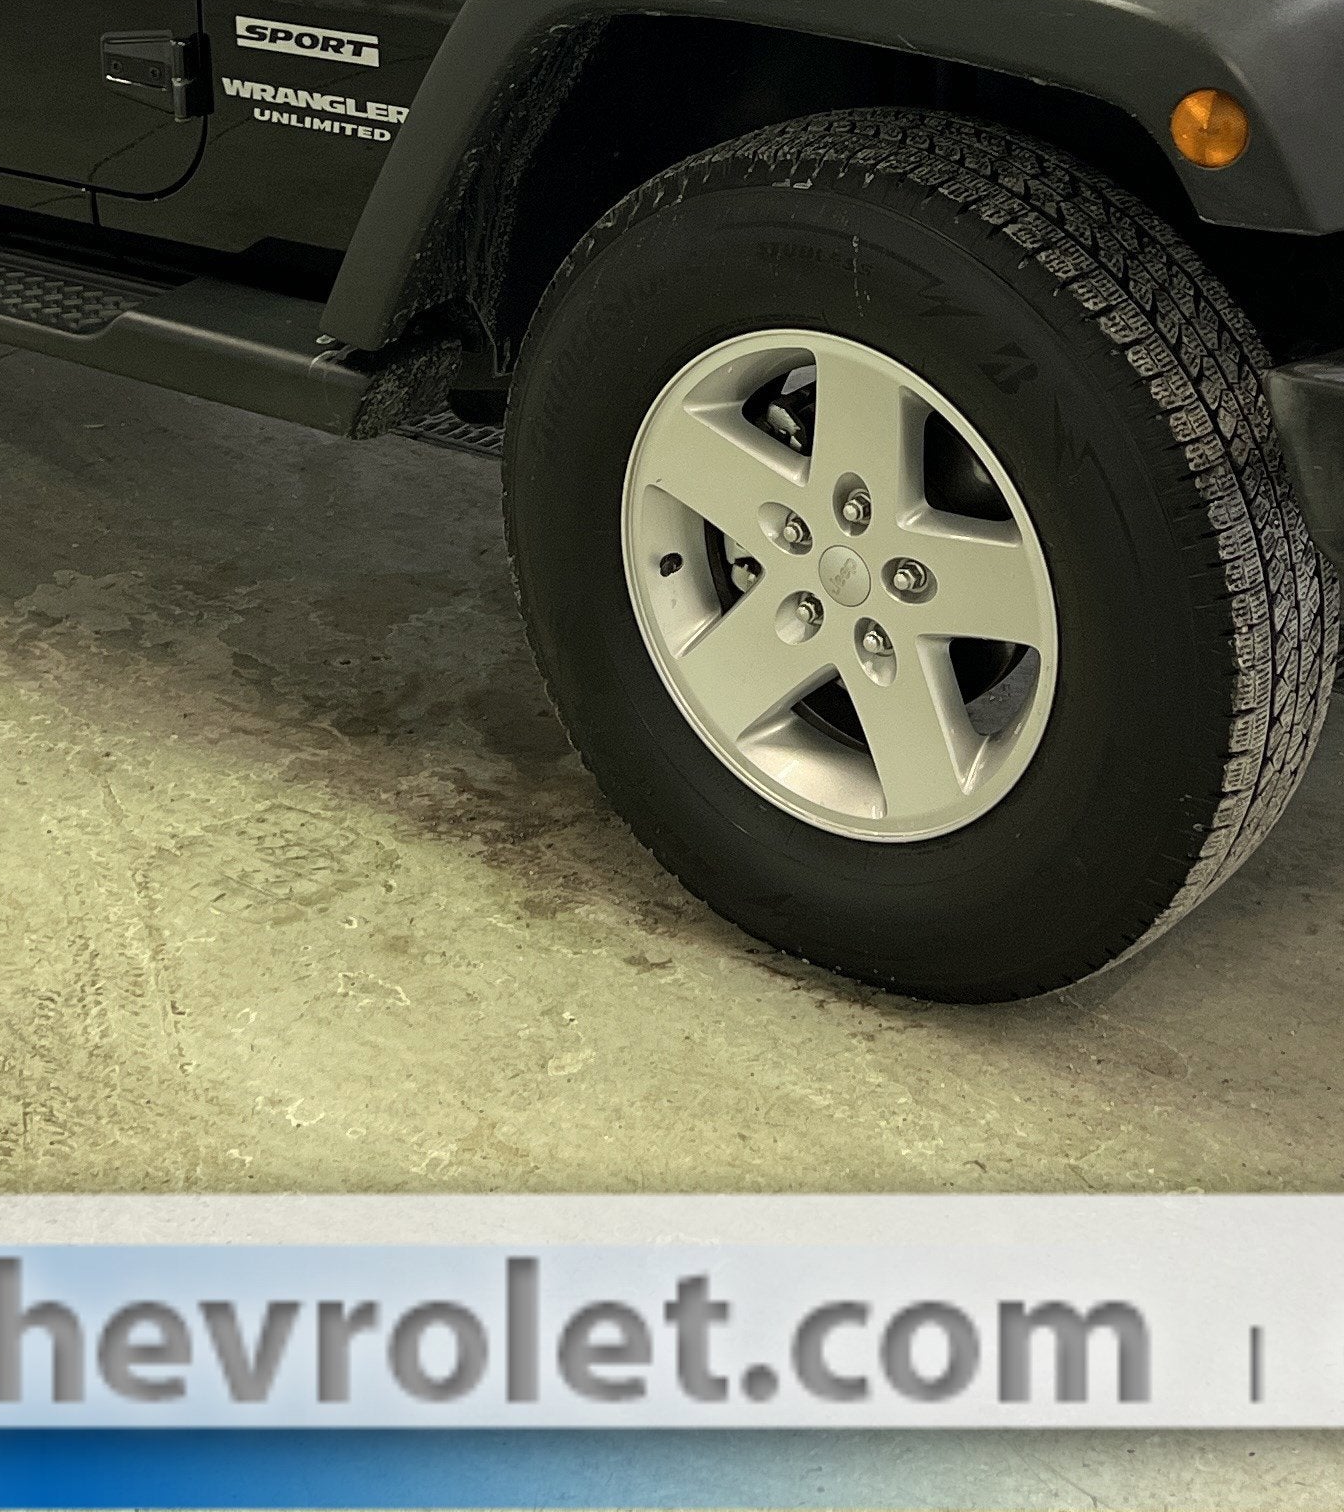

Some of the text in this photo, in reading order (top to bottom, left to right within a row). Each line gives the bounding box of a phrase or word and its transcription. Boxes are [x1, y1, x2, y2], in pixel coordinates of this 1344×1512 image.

[244, 22, 379, 59] SPORT
[221, 76, 410, 124] WRANGLER
[253, 107, 392, 142] UNLIMITED
